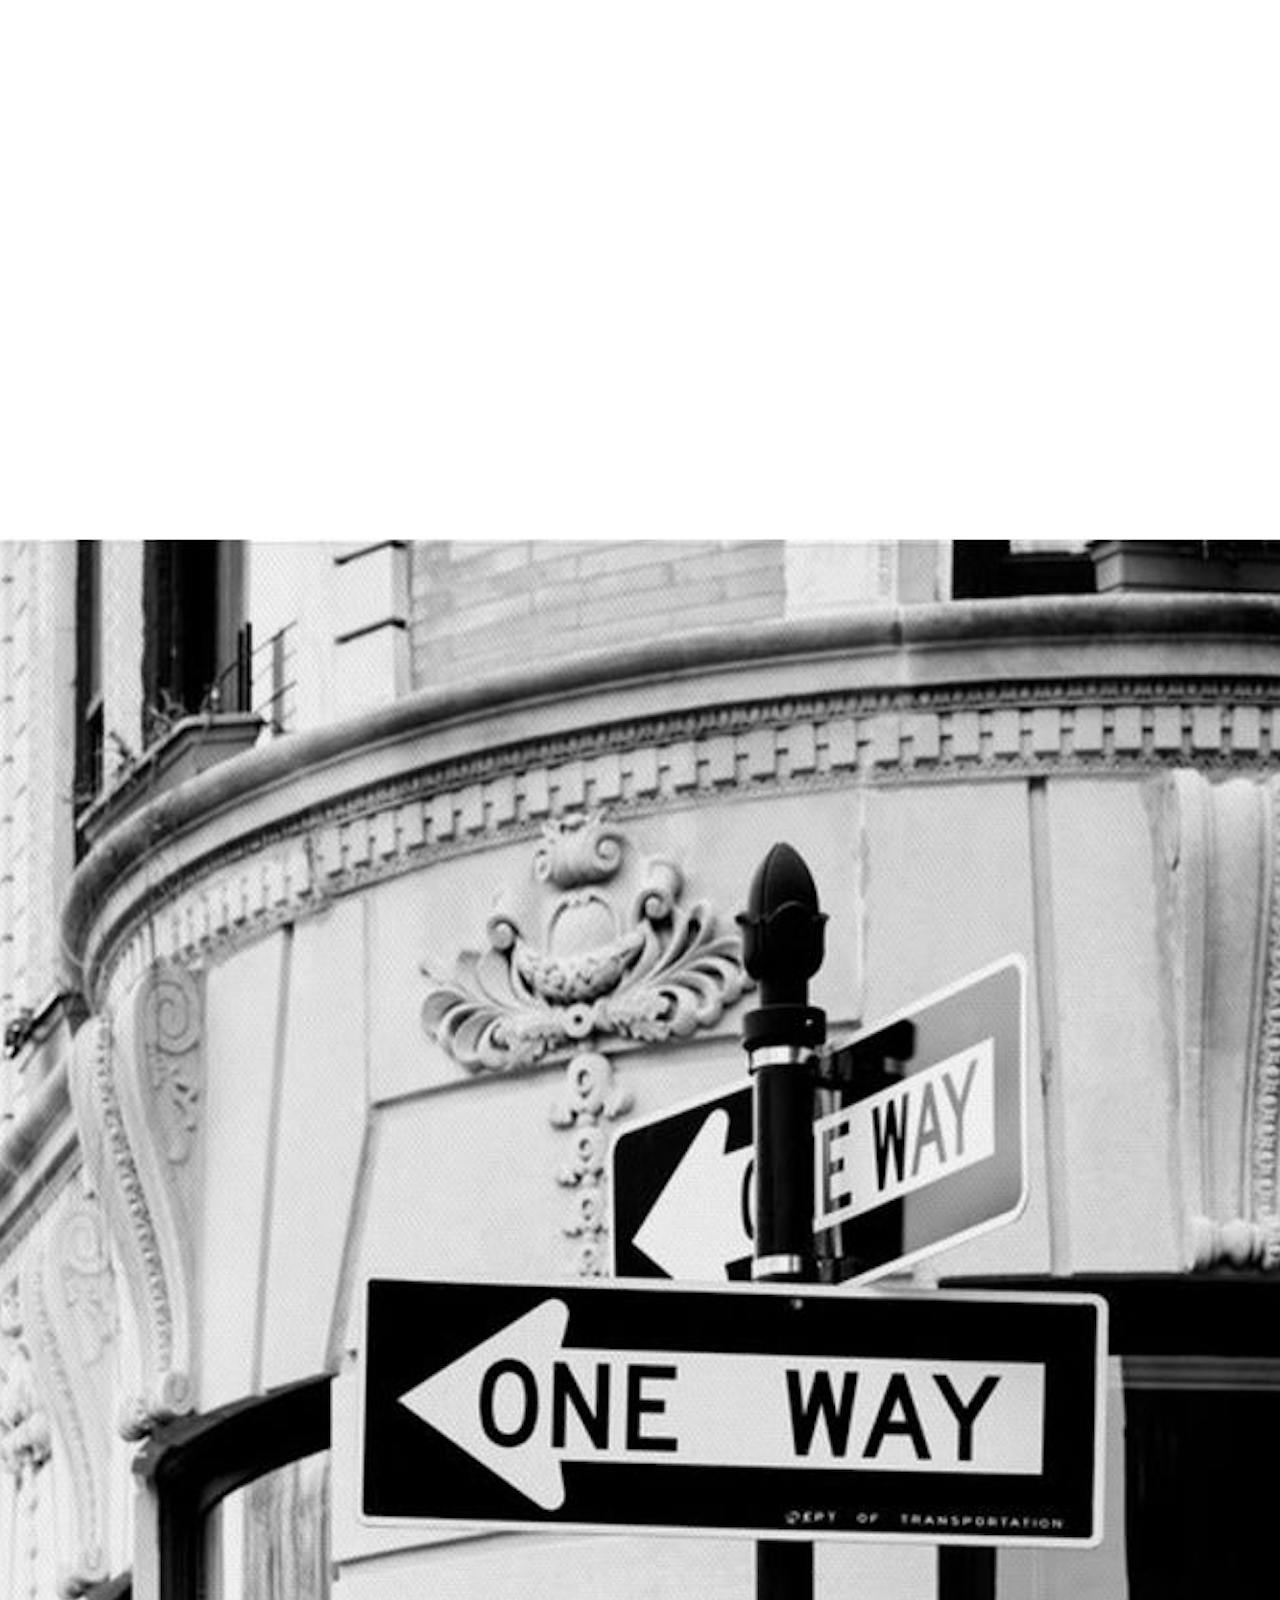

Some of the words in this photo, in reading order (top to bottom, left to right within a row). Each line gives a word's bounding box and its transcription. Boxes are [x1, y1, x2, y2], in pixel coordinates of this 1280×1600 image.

[871, 1059, 978, 1192] WAY
[479, 1358, 678, 1452] ONE
[785, 1369, 1001, 1462] WAY
[855, 1511, 879, 1524] OF
[900, 1513, 1064, 1530] TRANSPORTATION
